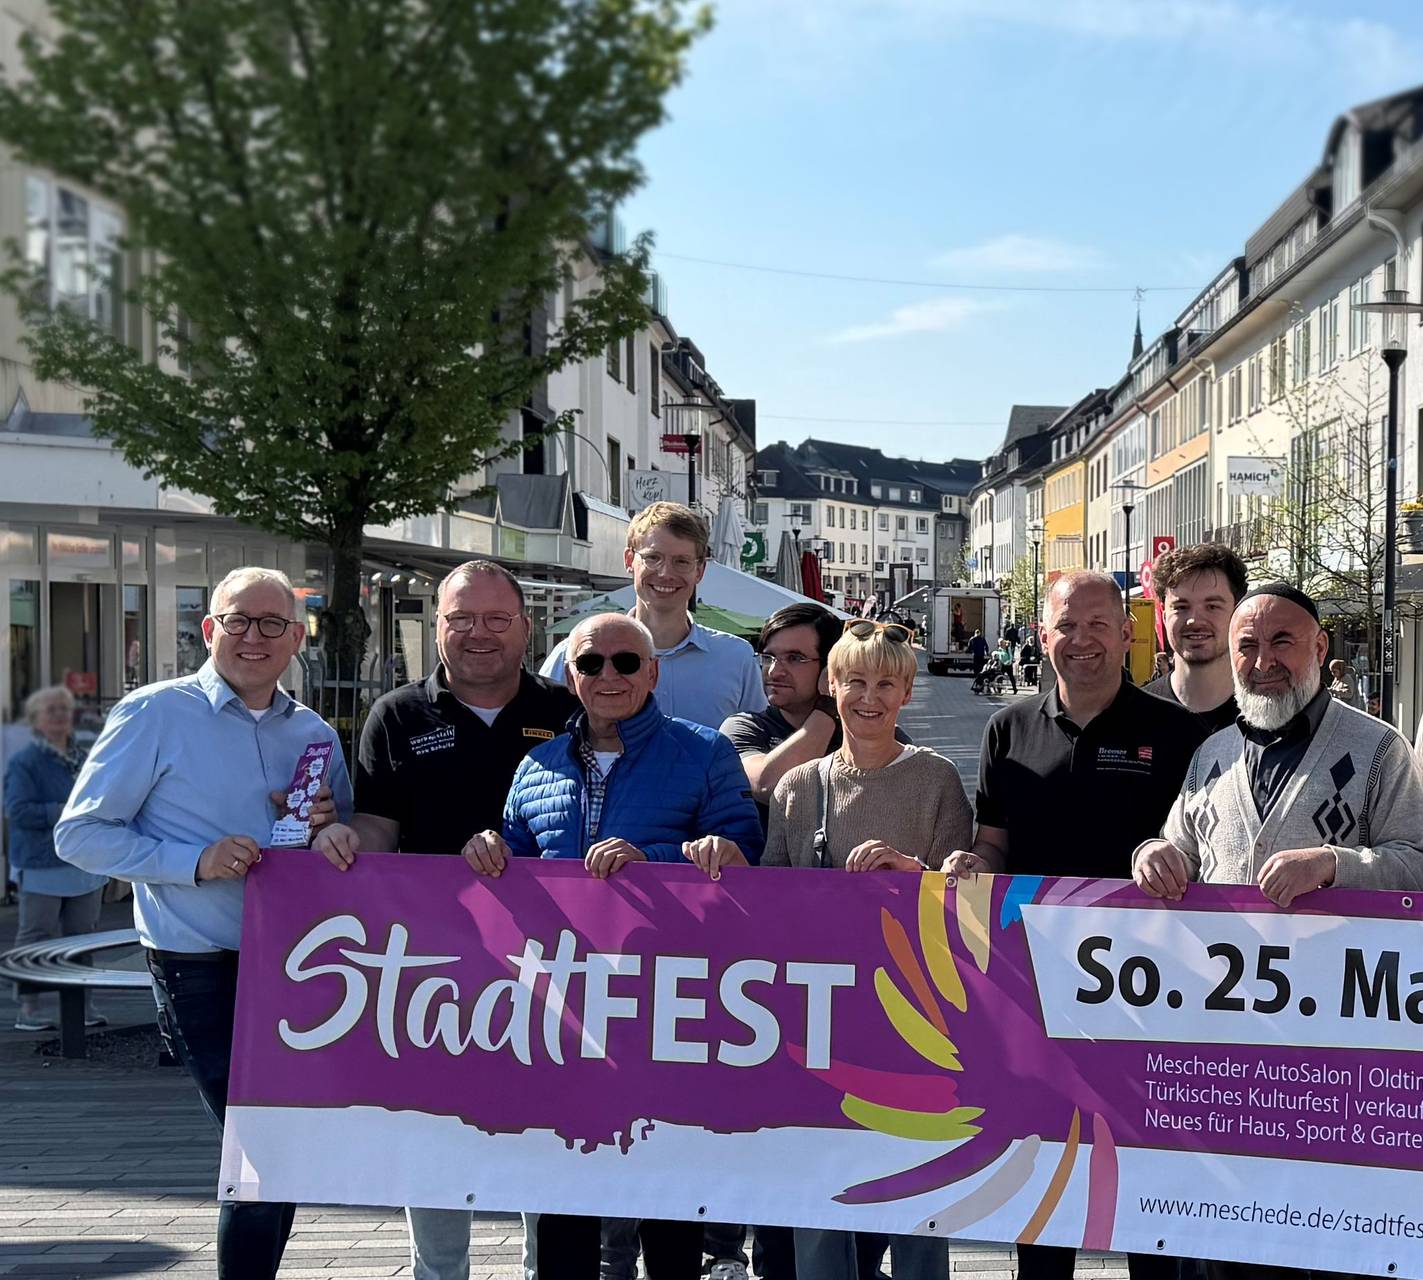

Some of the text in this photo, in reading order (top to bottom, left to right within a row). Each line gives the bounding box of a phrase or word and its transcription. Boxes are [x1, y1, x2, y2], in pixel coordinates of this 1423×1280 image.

[278, 914, 856, 1070] StadtFEST
[1076, 935, 1183, 1009] So.
[1204, 943, 1317, 1017] 25.
[1146, 1053, 1249, 1078] Mescheder
[1254, 1060, 1351, 1086] AutoSalon
[1145, 1080, 1242, 1106] Türkisches
[1248, 1087, 1339, 1114] Kulturfest
[1145, 1107, 1202, 1132] Neues
[1207, 1111, 1234, 1133] für
[1239, 1115, 1291, 1140] Haus,
[1295, 1119, 1346, 1145] Sport
[1351, 1123, 1365, 1144] &
